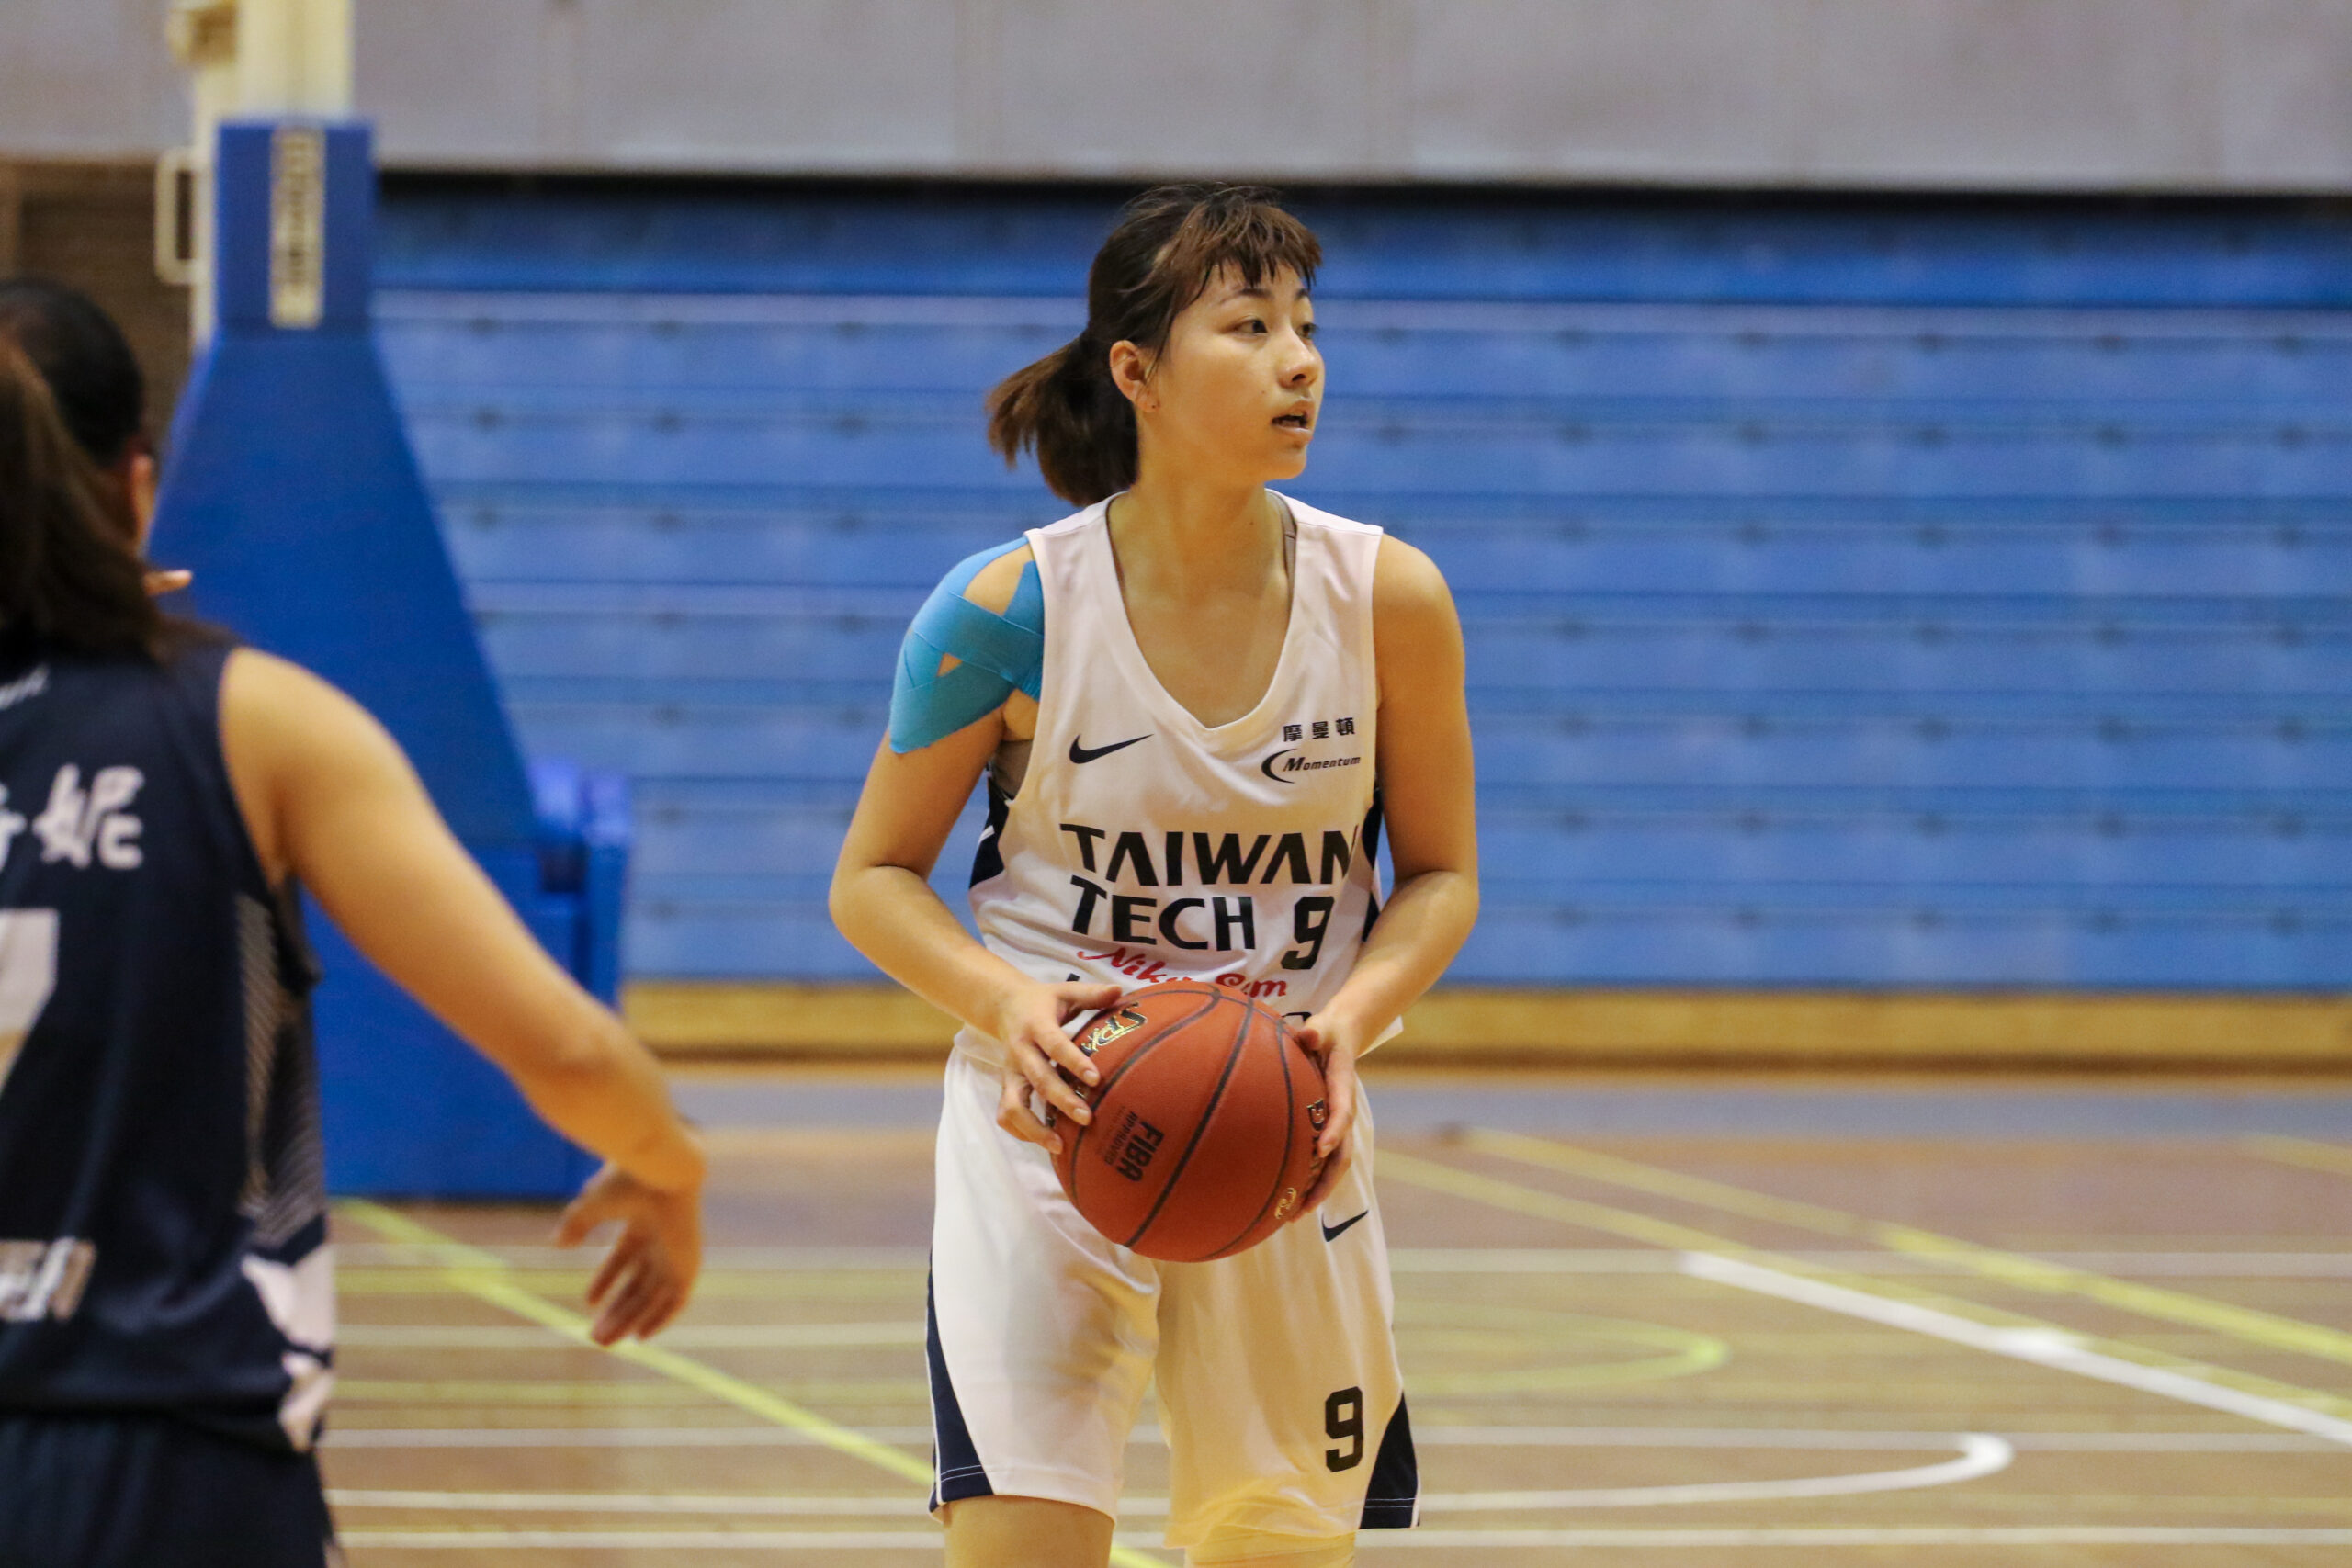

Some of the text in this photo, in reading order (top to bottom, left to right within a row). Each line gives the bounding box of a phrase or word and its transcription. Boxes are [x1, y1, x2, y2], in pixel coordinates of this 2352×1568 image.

[1283, 717, 1355, 742] 摩曼頓
[1283, 756, 1362, 772] Momentum
[1059, 823, 1358, 886] TAIWAN
[1070, 874, 1256, 951] TECH
[1281, 896, 1335, 970] 9
[1117, 1121, 1165, 1182] FIBA
[1325, 1386, 1363, 1472] 9
